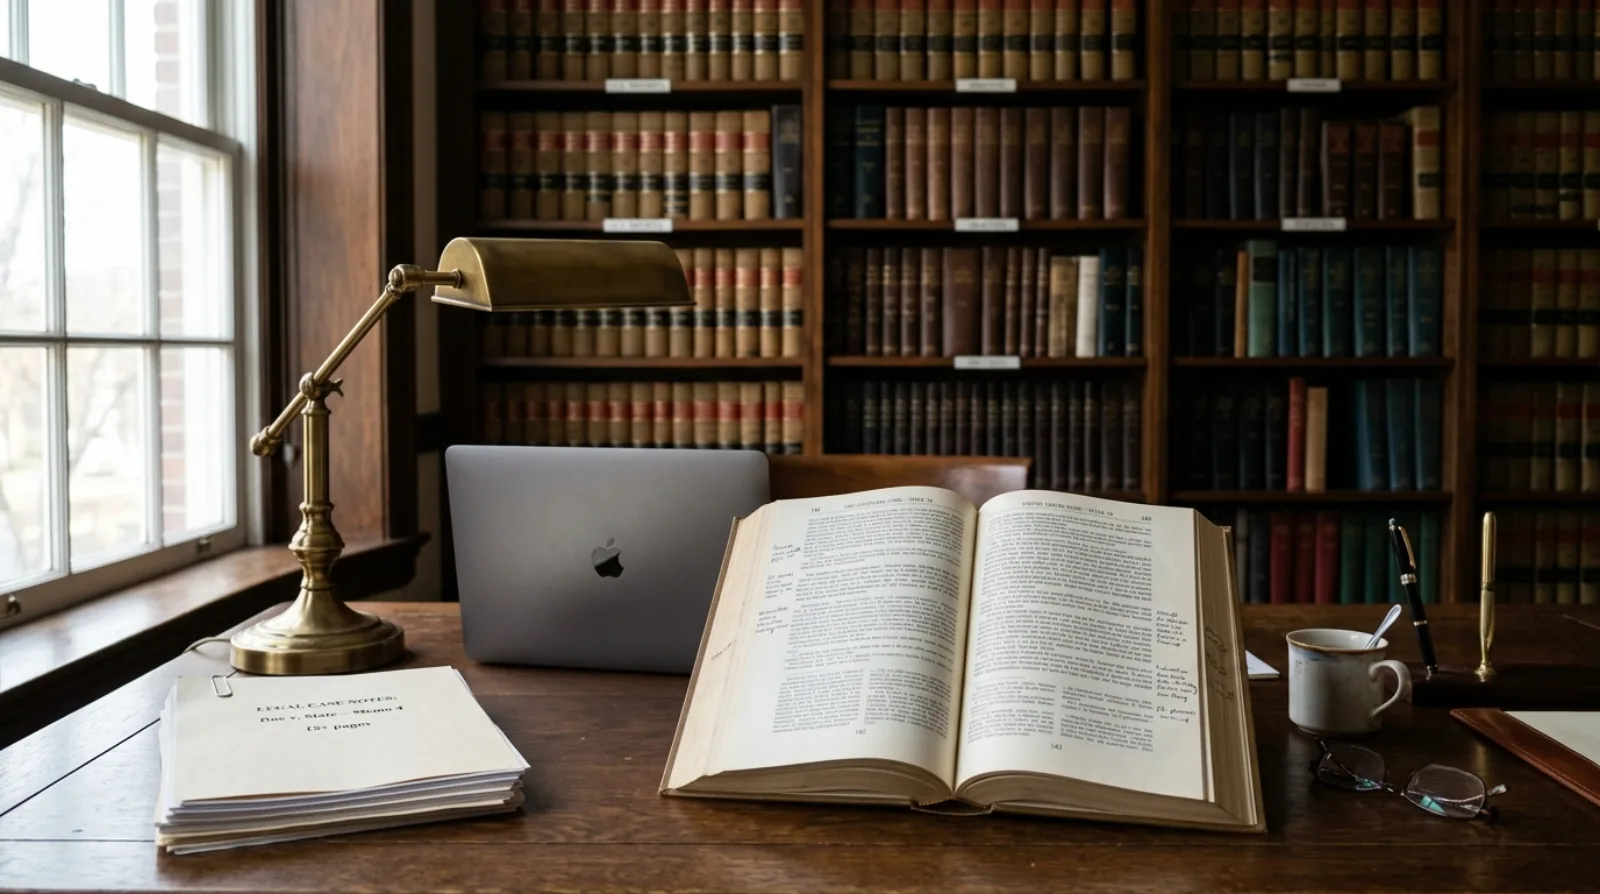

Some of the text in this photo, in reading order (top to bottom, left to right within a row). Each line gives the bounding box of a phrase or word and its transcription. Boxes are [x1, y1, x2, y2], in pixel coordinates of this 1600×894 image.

[256, 703, 304, 712] LEGAL
[307, 700, 344, 709] CASE
[333, 721, 372, 731] pages
